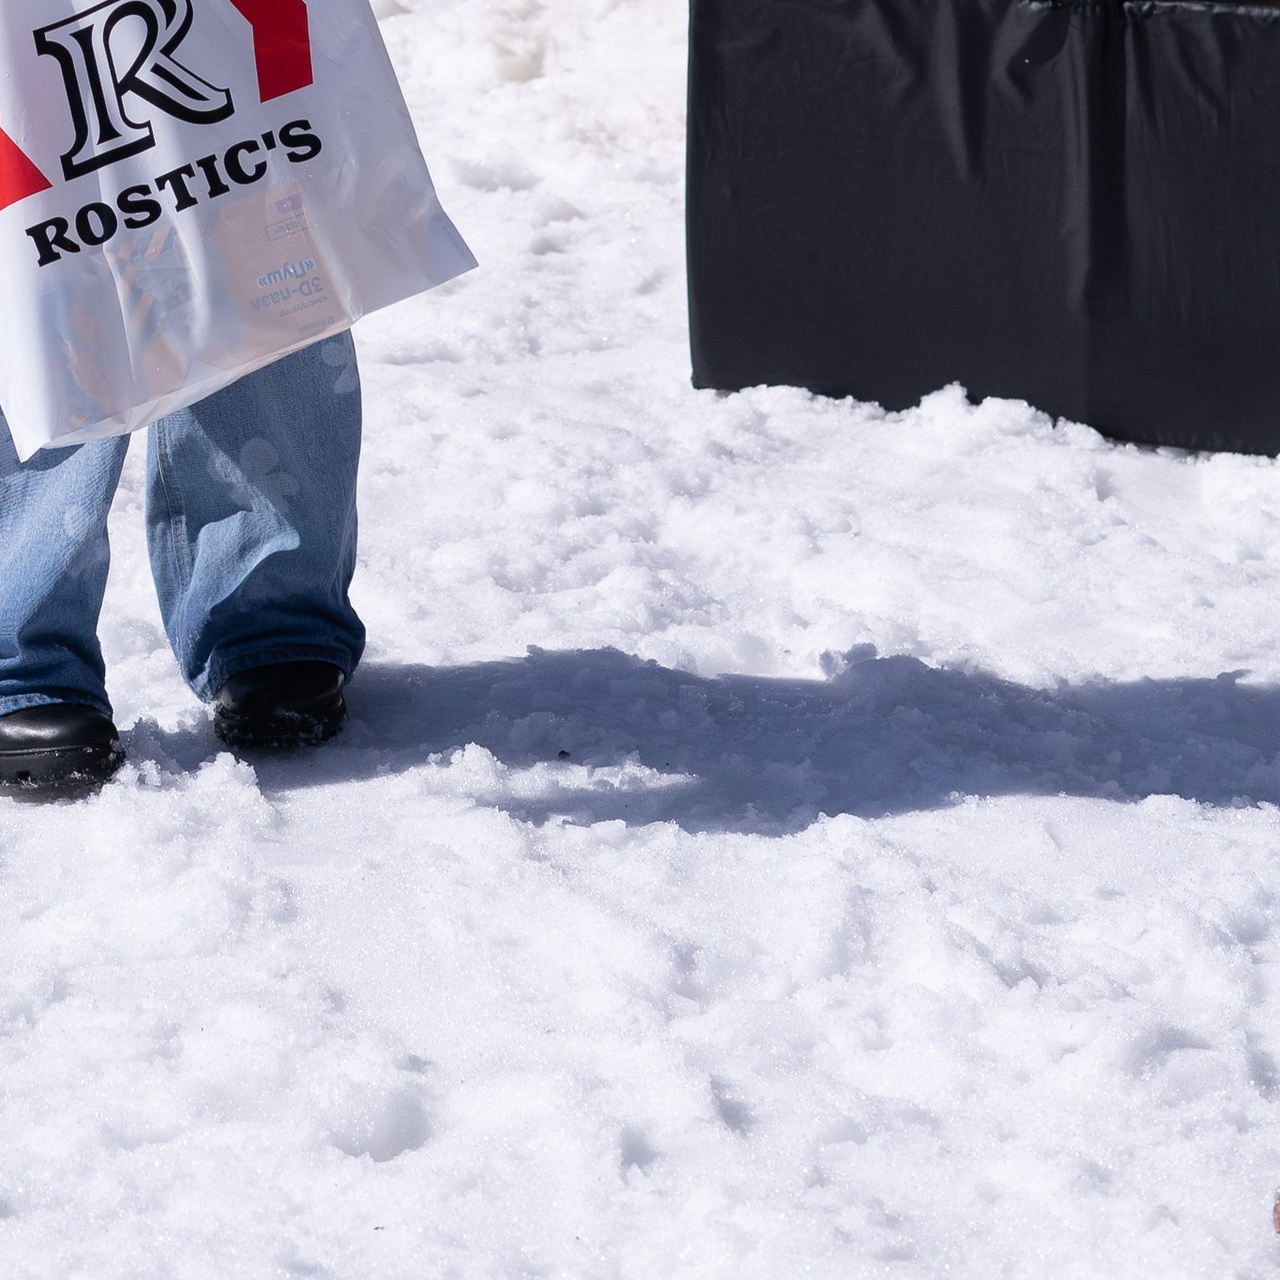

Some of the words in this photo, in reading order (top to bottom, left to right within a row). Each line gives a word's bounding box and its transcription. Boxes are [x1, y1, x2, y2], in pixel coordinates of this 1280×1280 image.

[24, 119, 323, 268] ROSTIC'S
[258, 260, 314, 287] «Пуш»
[251, 276, 324, 311] 3D-пазл
